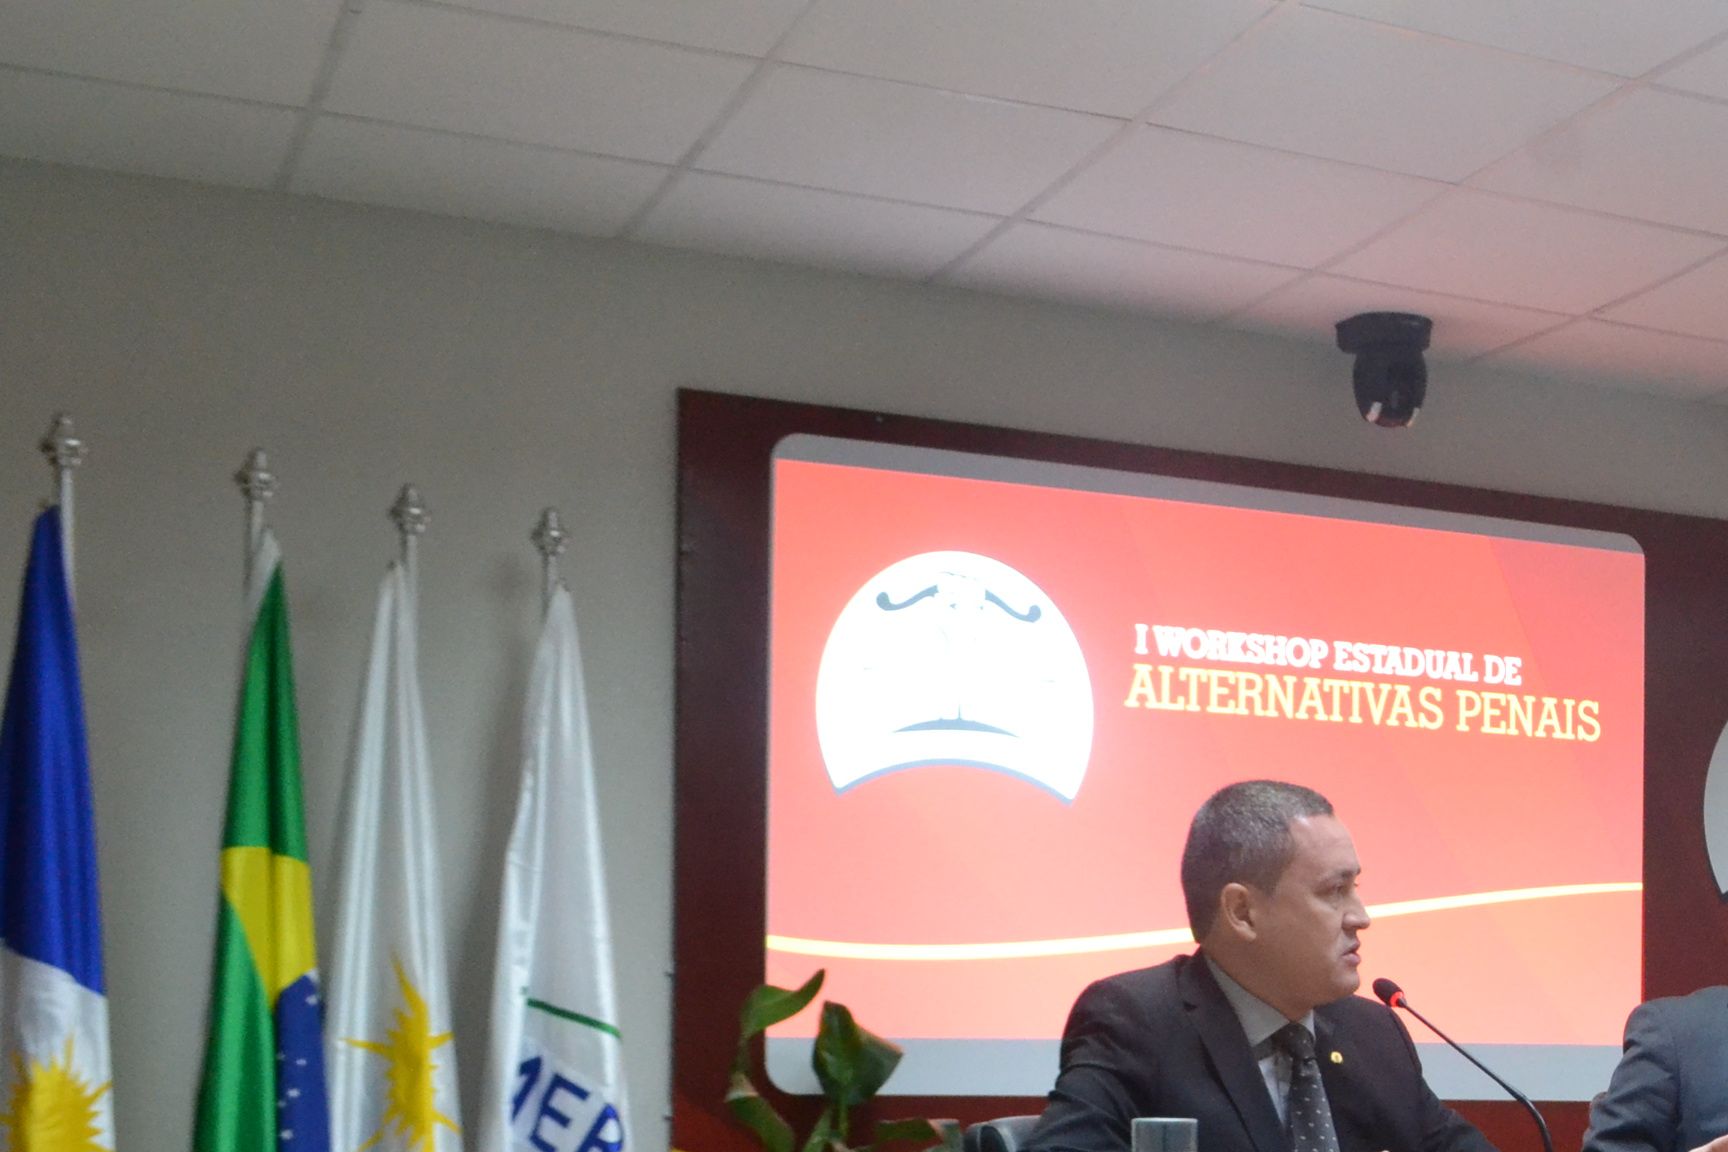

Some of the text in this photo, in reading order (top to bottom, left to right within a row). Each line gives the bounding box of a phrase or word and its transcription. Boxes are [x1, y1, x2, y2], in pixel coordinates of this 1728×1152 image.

[1135, 624, 1522, 685] I WORKSHOP ESTADUAL DE
[1124, 664, 1601, 742] ALTERNATIVAS PENAIS
